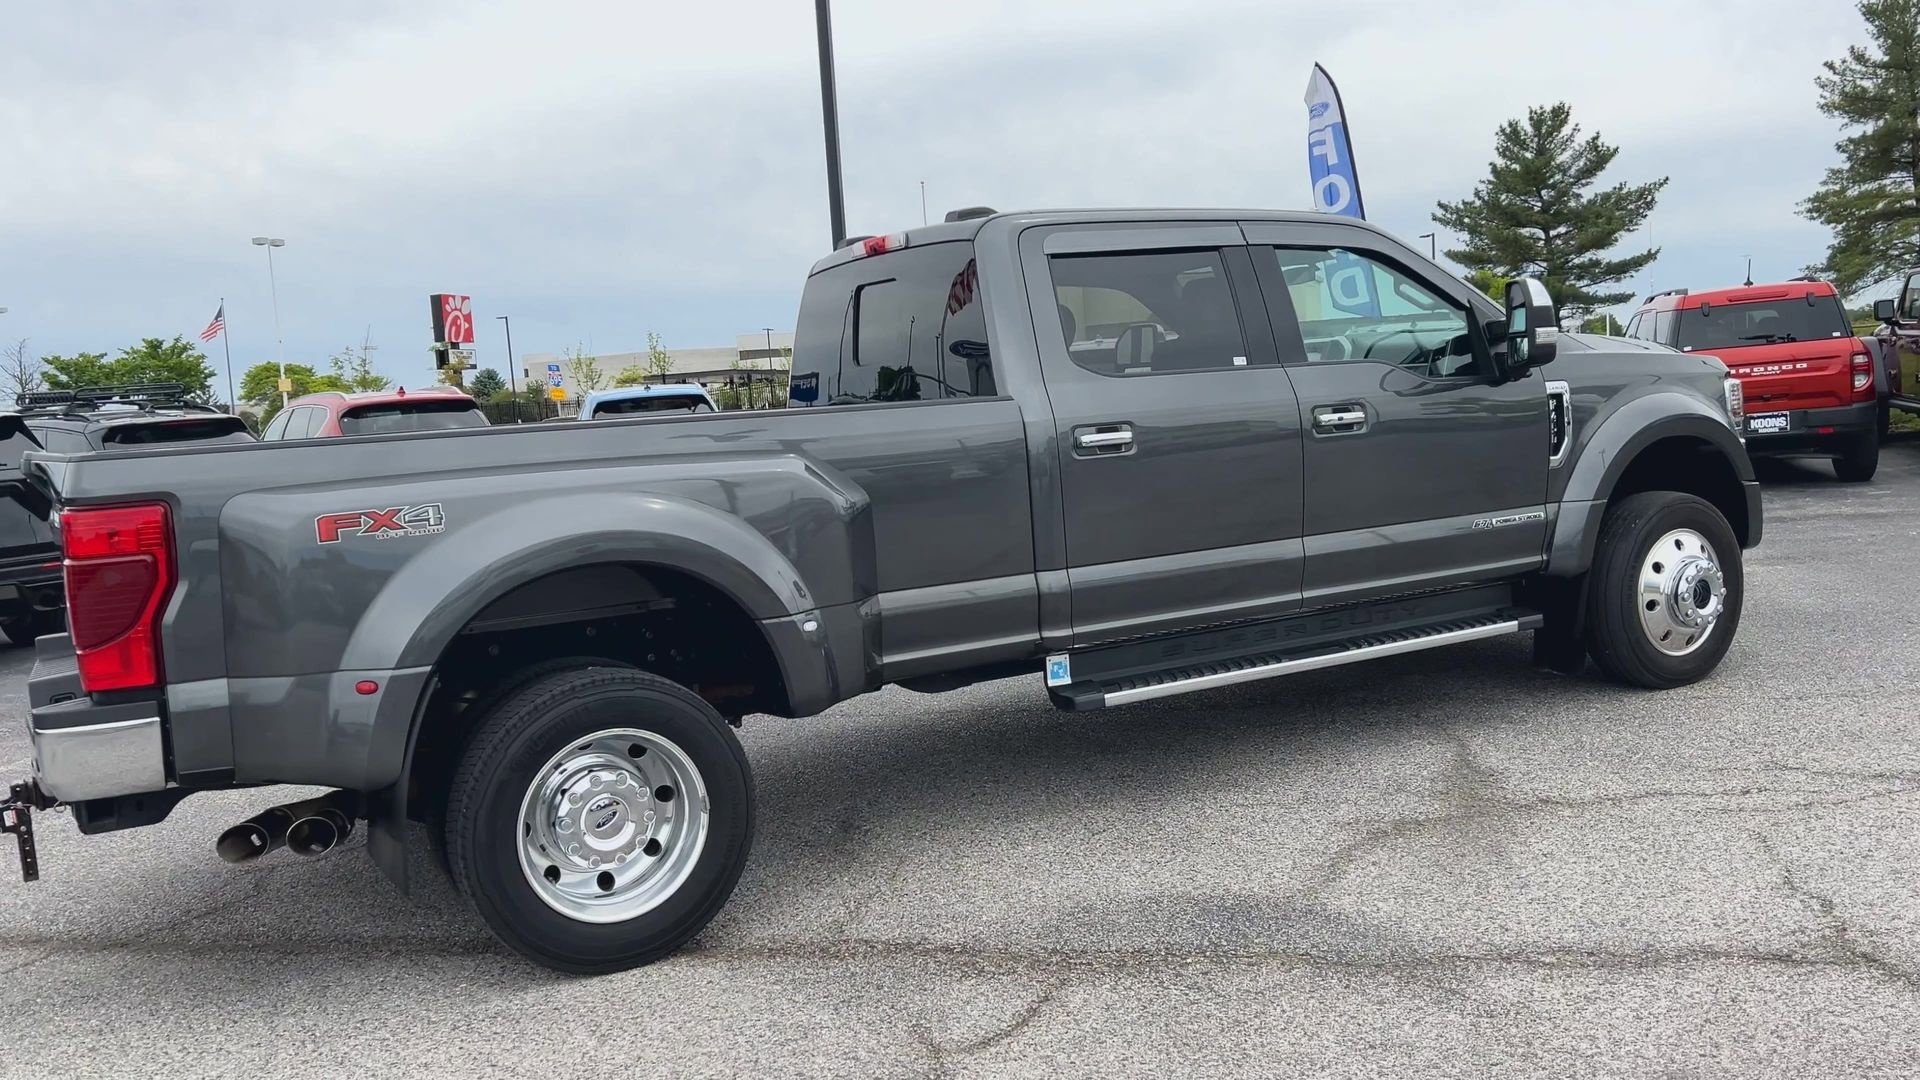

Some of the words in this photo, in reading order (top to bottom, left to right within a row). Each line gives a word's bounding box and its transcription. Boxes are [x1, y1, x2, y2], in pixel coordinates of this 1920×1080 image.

[549, 376, 563, 385] 695
[1750, 416, 1787, 429] KOONS
[315, 503, 445, 545] FX4
